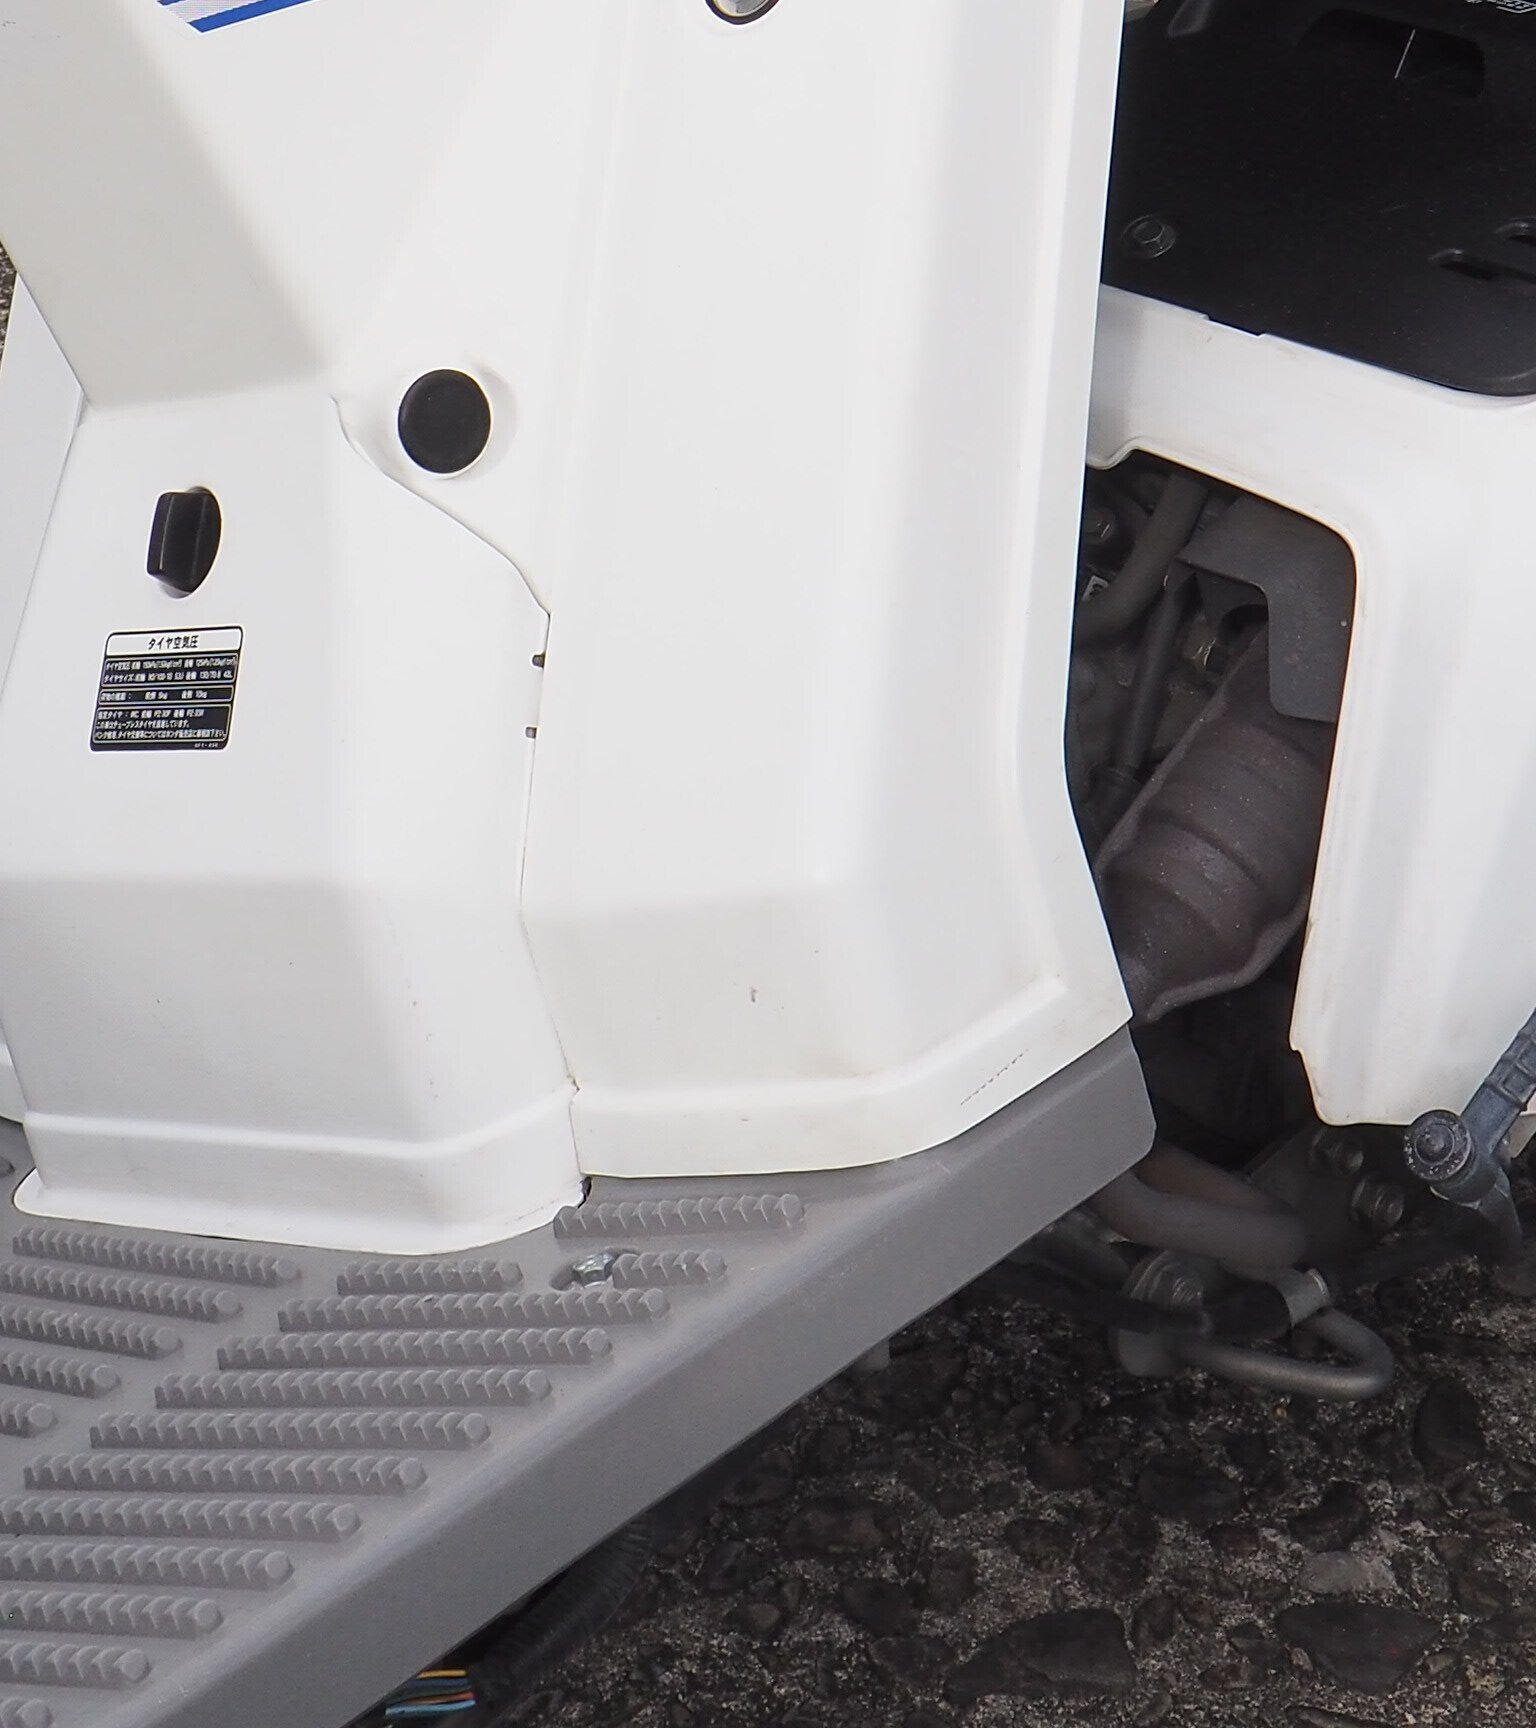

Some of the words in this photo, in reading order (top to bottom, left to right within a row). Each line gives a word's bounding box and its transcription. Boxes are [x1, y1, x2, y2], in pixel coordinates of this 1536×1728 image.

[148, 635, 200, 651] タイヤ空気圧
